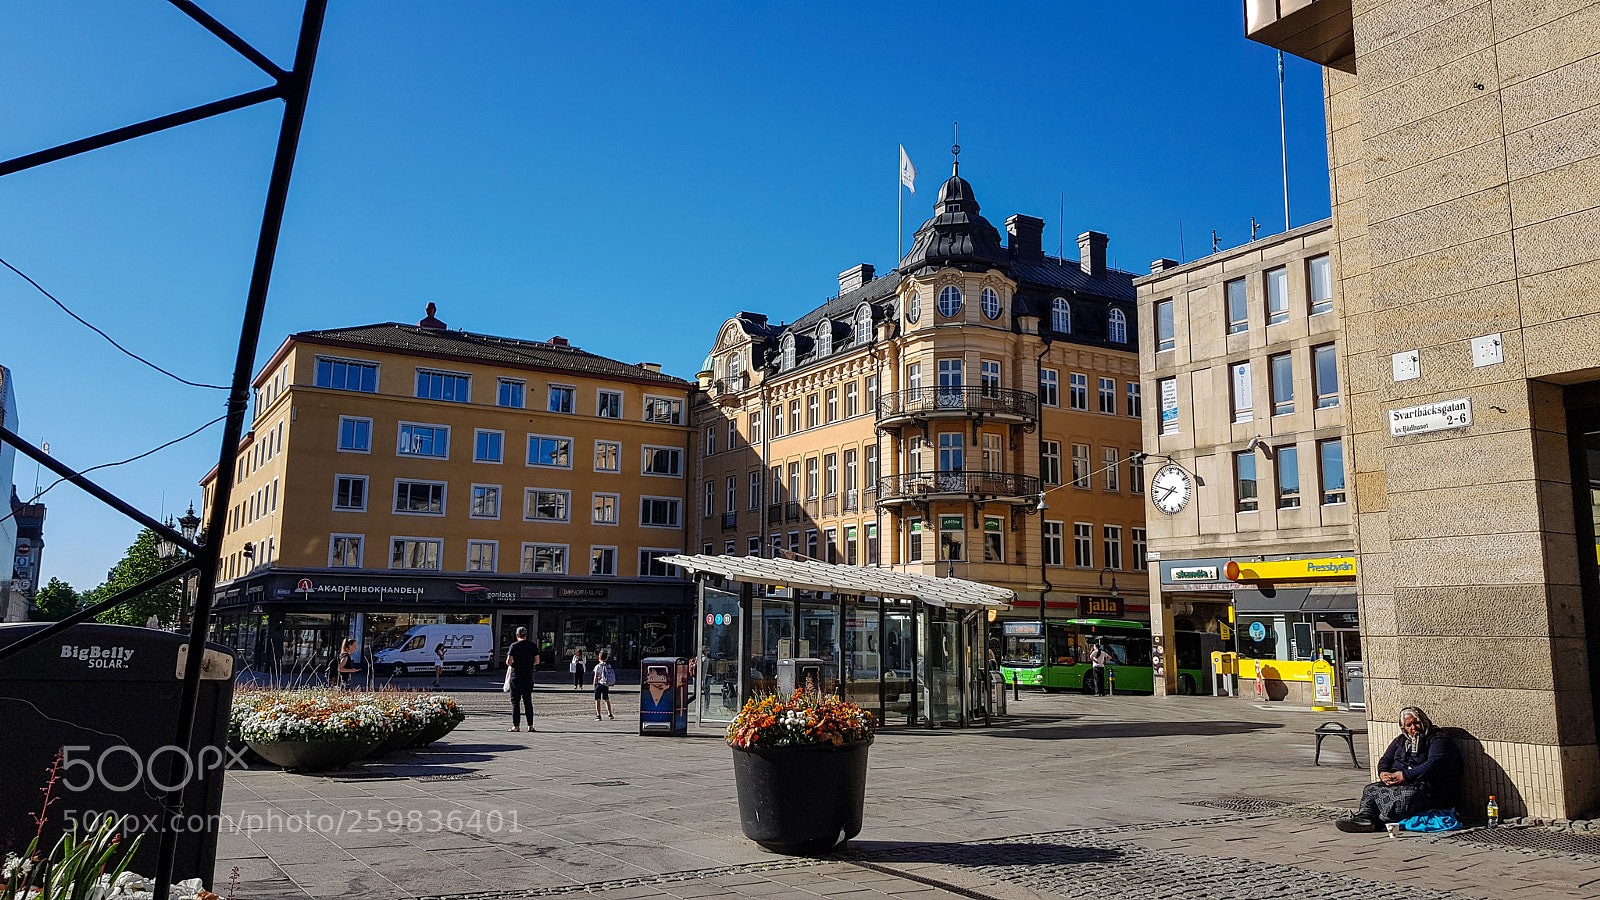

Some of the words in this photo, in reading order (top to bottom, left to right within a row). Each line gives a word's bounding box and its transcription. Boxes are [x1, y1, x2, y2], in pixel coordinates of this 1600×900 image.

[1393, 402, 1467, 421] Svartbäcksgatan
[1446, 413, 1467, 426] 2-6
[1307, 562, 1353, 573] Pressbyrån
[317, 585, 424, 594] AKADEMIBOKHANDELN
[1087, 597, 1117, 614] jalla
[60, 645, 134, 661] BigBelly
[88, 659, 122, 668] SOLAR
